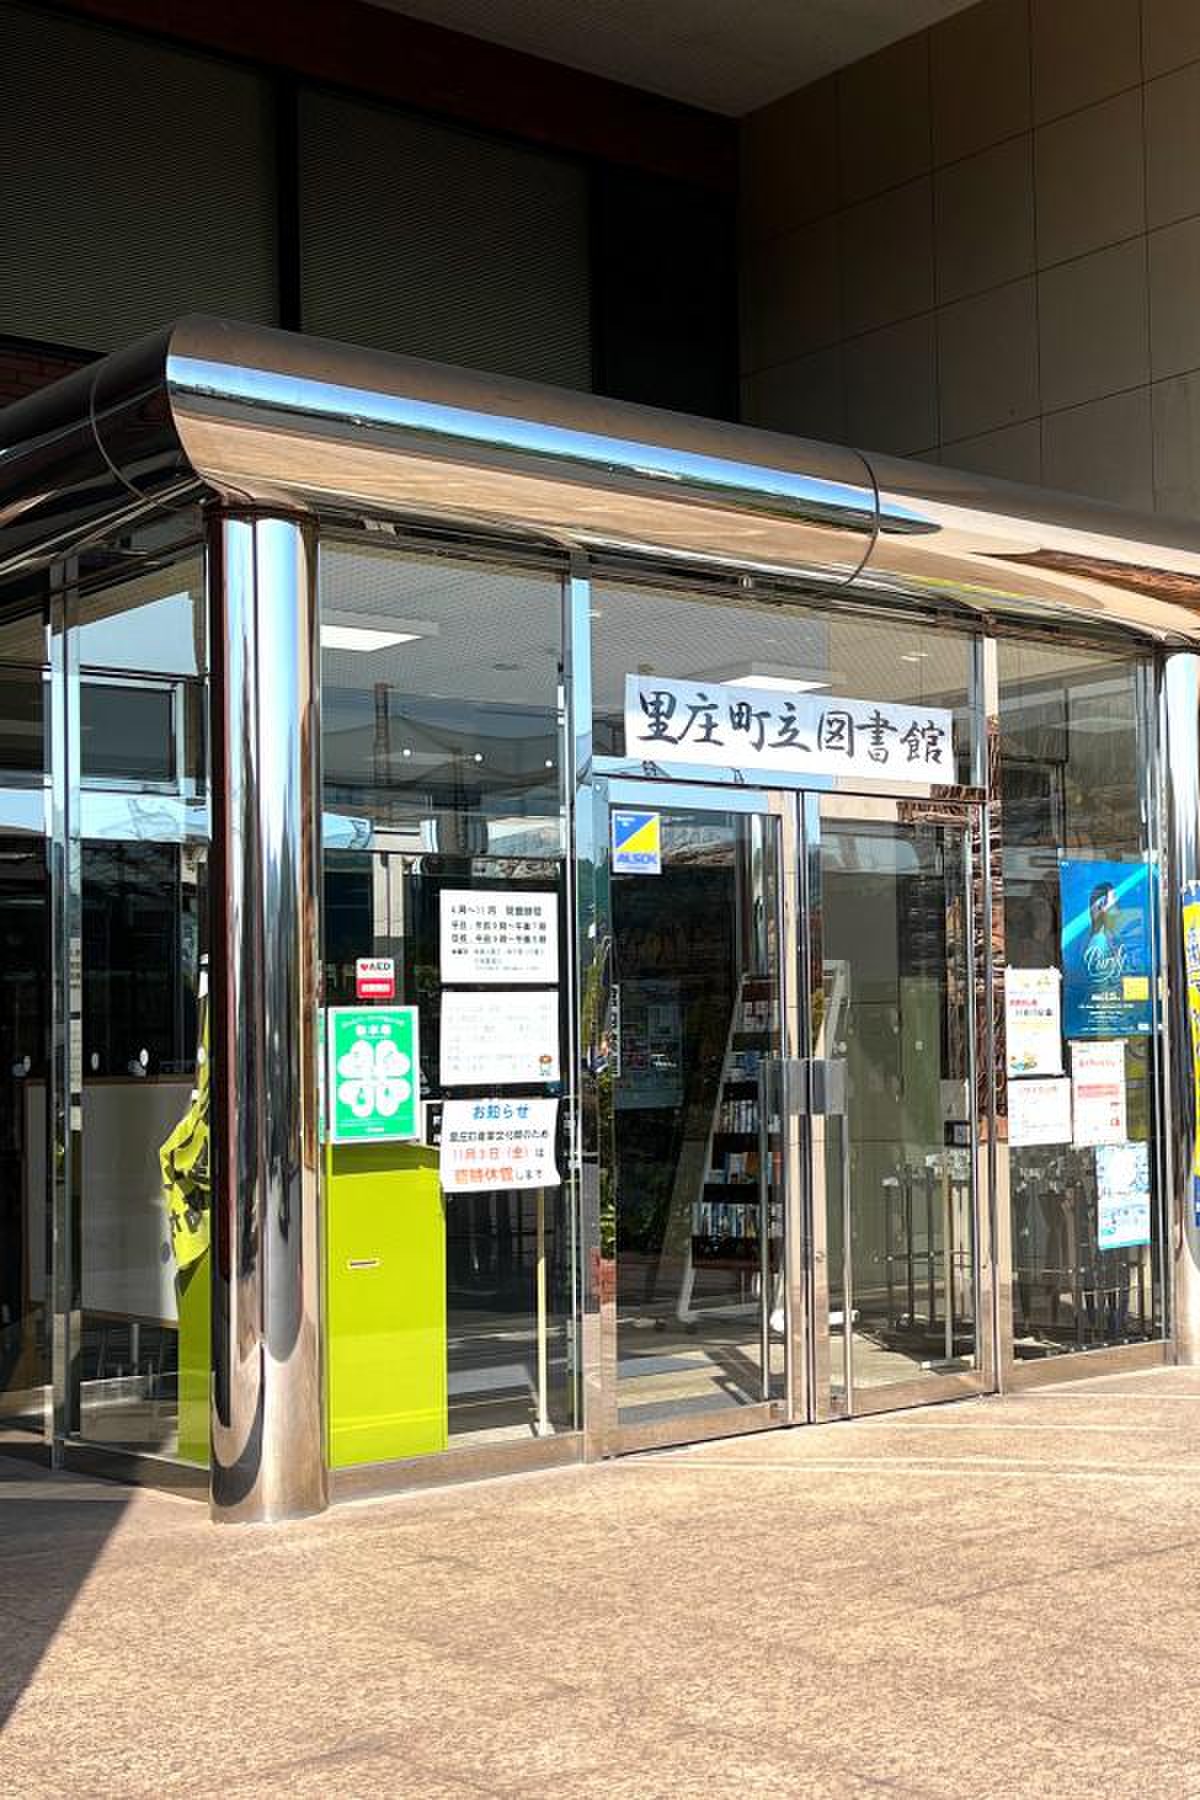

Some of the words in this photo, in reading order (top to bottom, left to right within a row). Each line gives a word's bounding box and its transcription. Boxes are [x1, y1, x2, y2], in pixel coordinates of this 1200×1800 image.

[637, 690, 946, 765] 里庄町立図書館
[616, 853, 657, 865] ALSOK
[369, 962, 391, 971] AED
[472, 1103, 530, 1120] お知らせ
